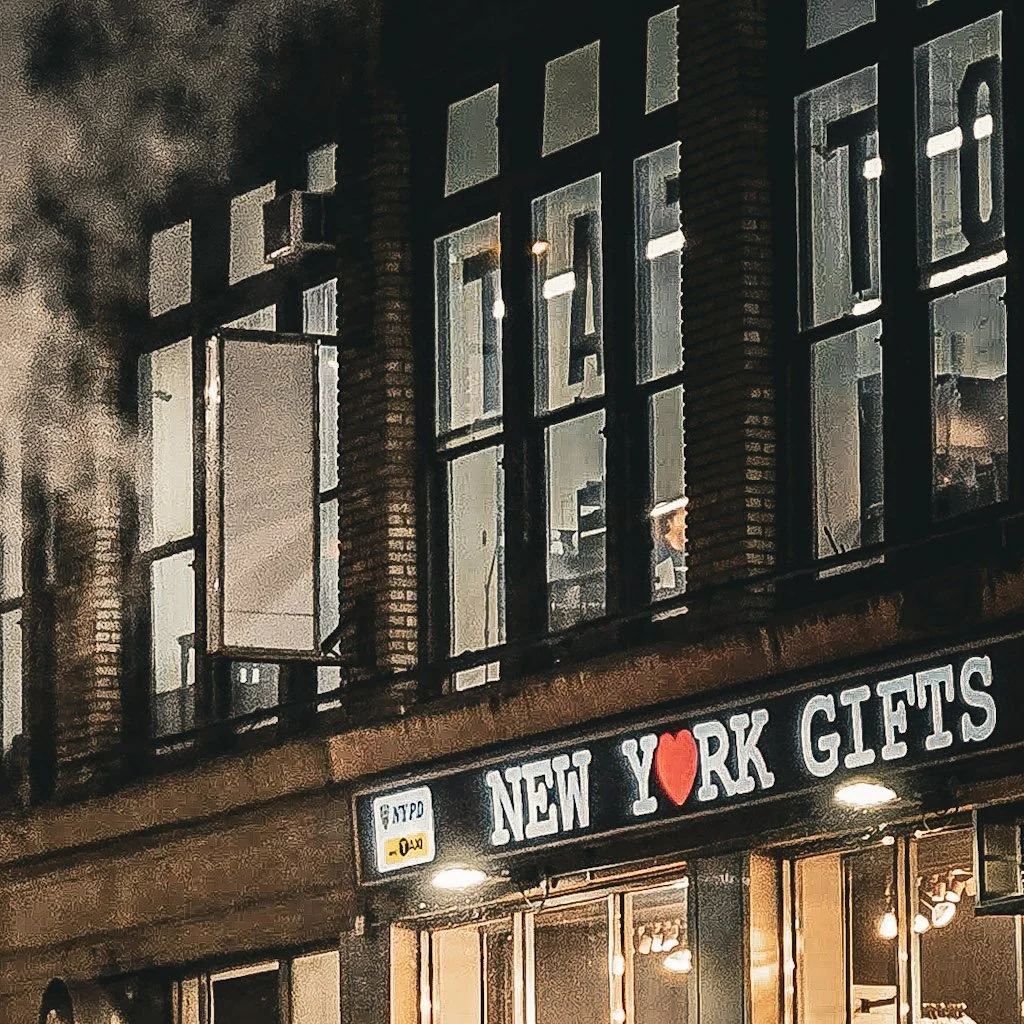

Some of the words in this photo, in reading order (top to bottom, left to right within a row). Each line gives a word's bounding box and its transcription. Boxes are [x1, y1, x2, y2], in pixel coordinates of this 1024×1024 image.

[486, 750, 592, 846] NEW
[801, 655, 996, 777] GIFTS
[392, 801, 424, 824] NYPD
